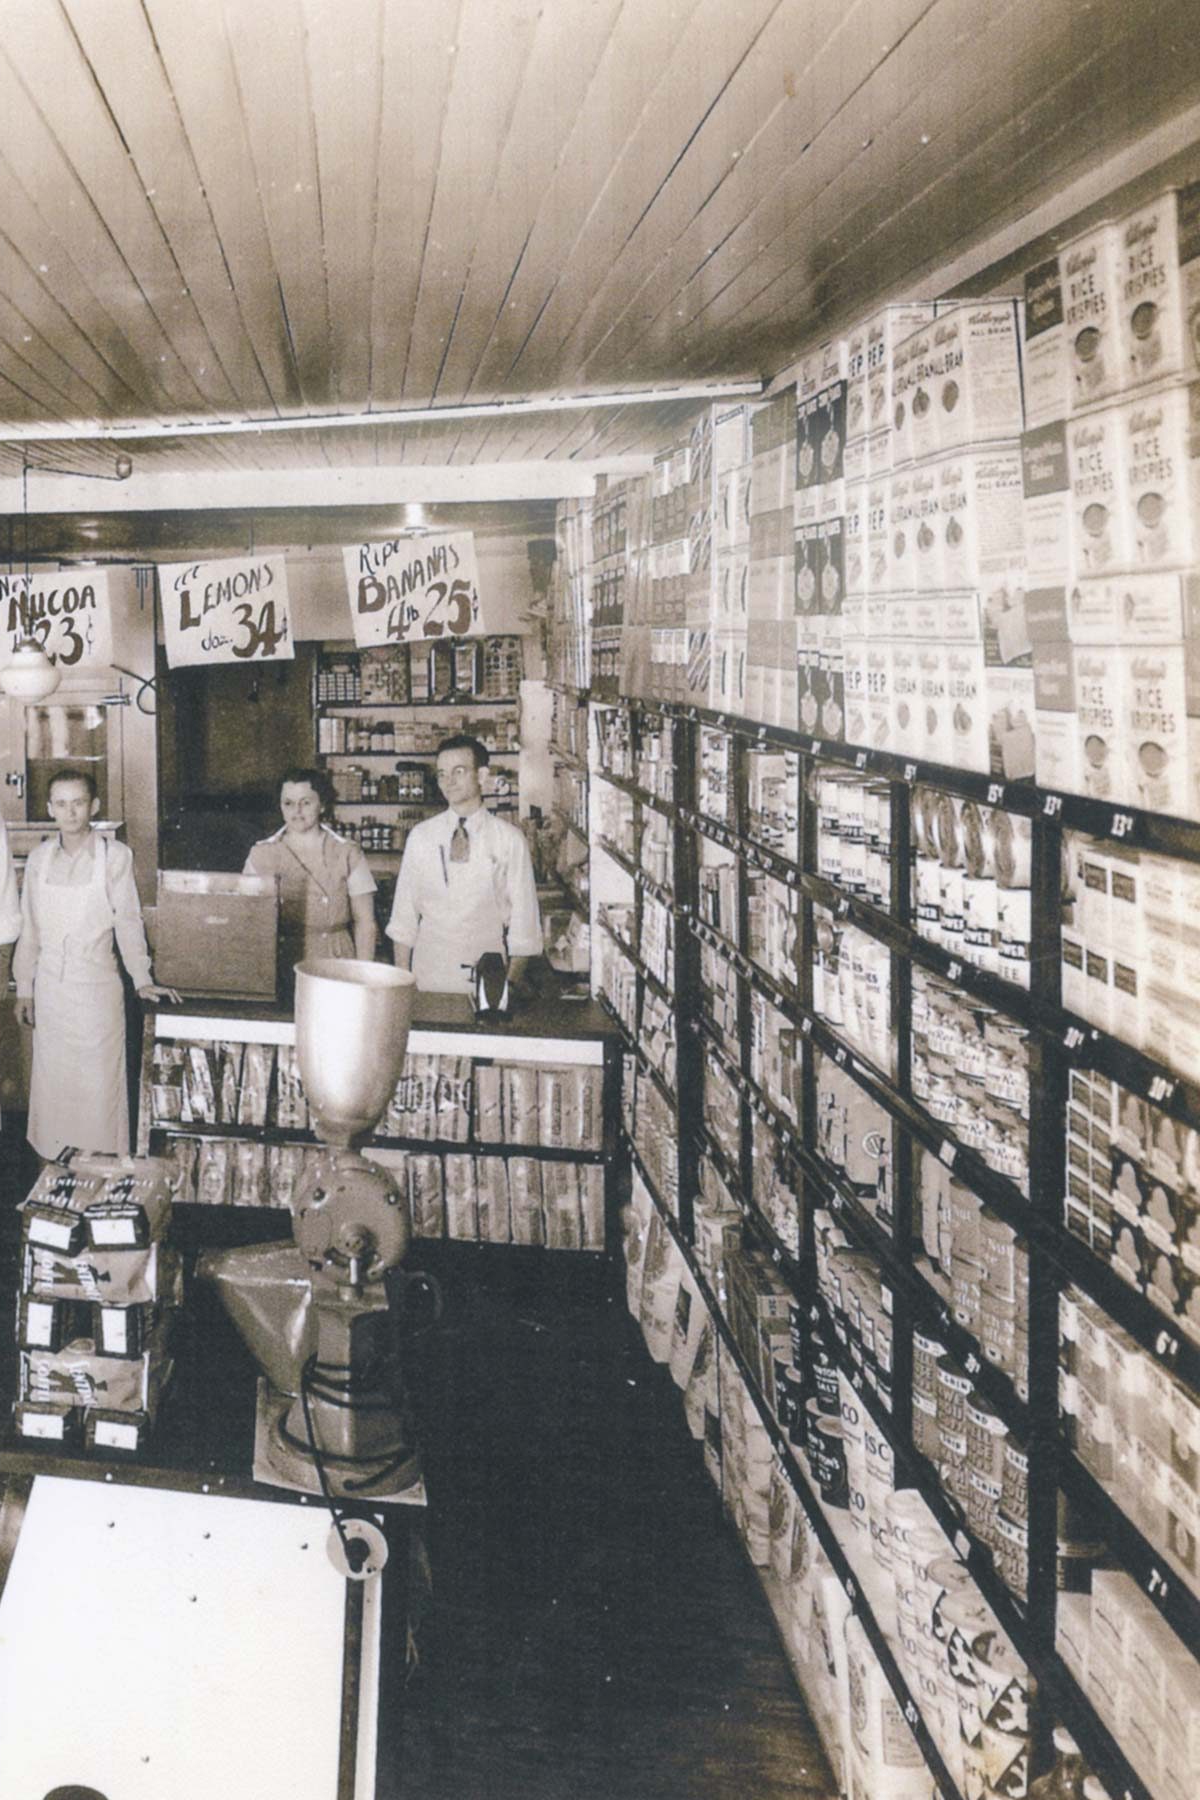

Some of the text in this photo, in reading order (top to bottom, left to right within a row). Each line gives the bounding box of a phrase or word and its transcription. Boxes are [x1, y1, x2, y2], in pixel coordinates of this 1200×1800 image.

[1071, 274, 1094, 299] RICE
[180, 564, 273, 632] LEMONS
[358, 544, 460, 614] BANANAS
[7, 585, 97, 633] NUCOA
